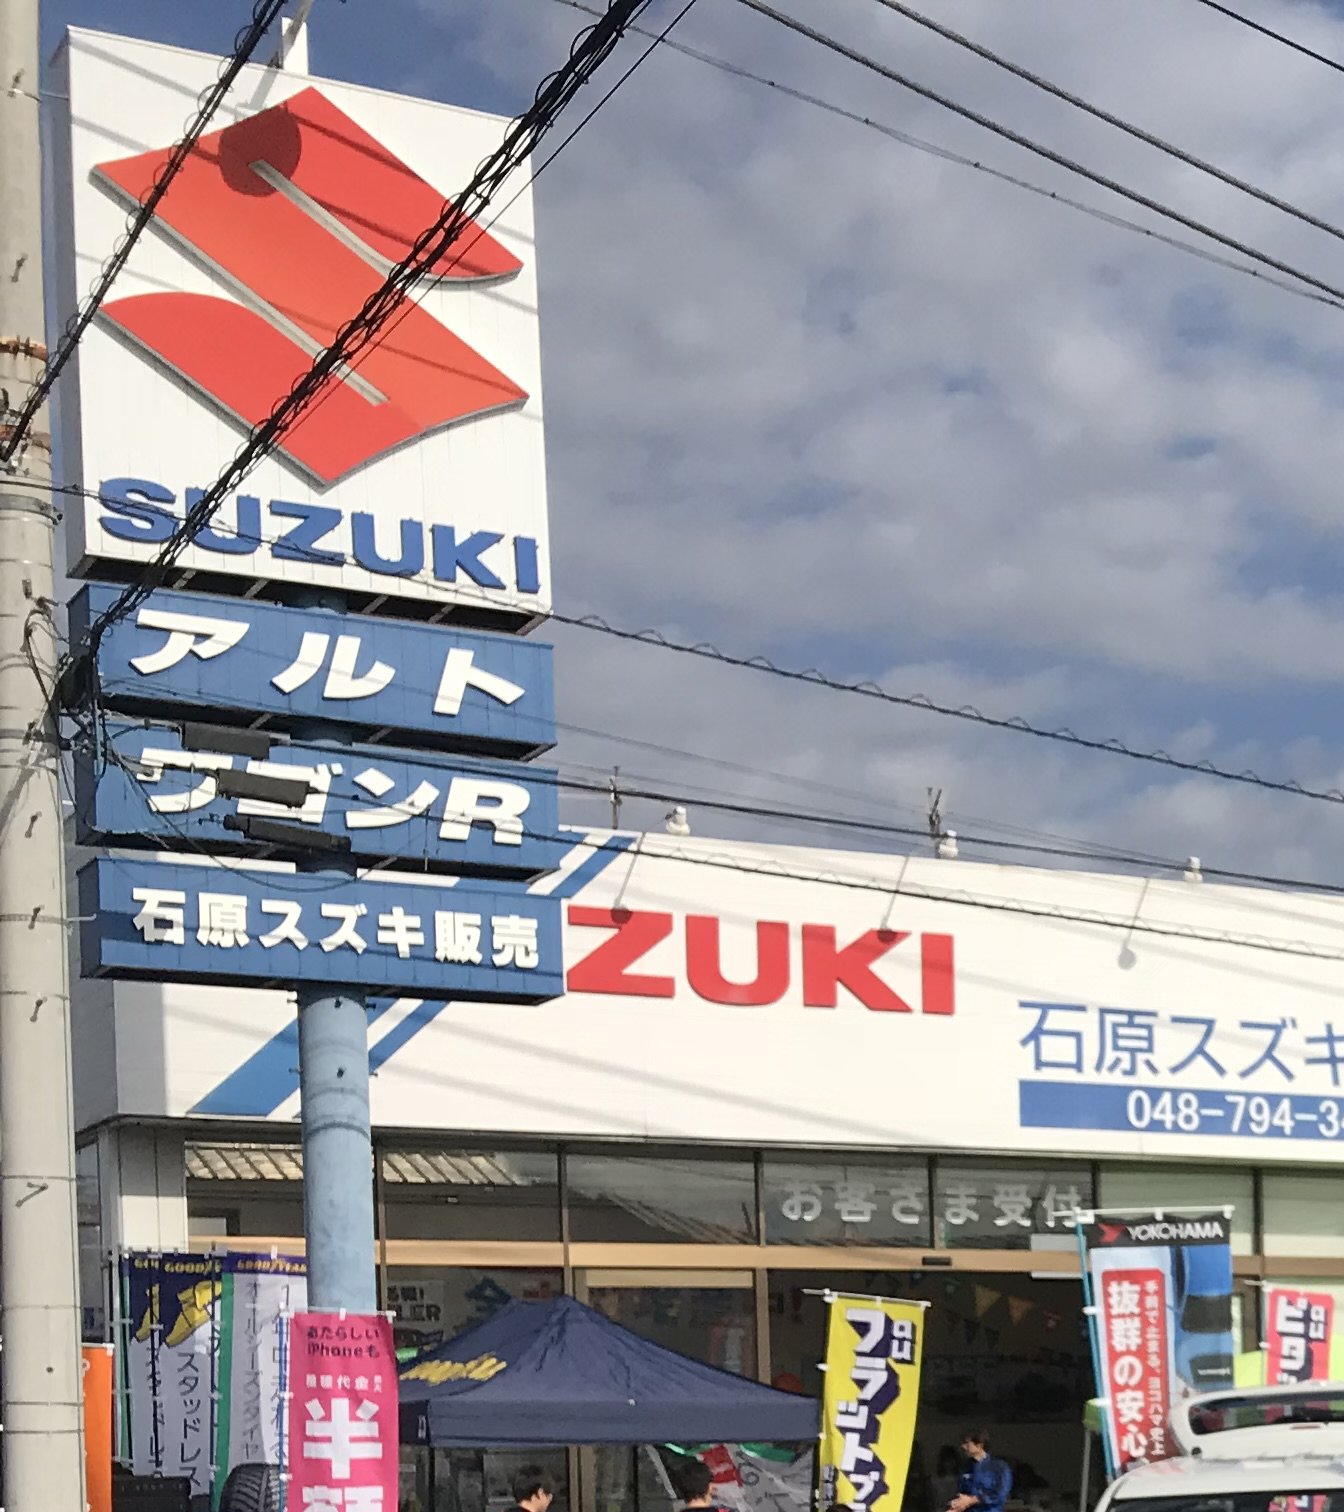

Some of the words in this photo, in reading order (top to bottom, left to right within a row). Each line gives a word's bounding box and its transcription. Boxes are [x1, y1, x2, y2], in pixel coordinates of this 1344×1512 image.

[99, 477, 540, 594] SUZUKI
[130, 608, 526, 716] アルト
[136, 748, 531, 845] ワゴンR
[132, 887, 540, 969] 石原スズキ販売
[565, 905, 956, 1017] ZUKI
[781, 1184, 1084, 1229] お客さま受付
[1128, 1221, 1224, 1241] YOKOHAMA
[307, 1326, 381, 1341] あたらしい
[890, 1319, 913, 1361] au
[1106, 1280, 1149, 1459] 抜群の安心
[176, 1351, 201, 1488] スタッドレス
